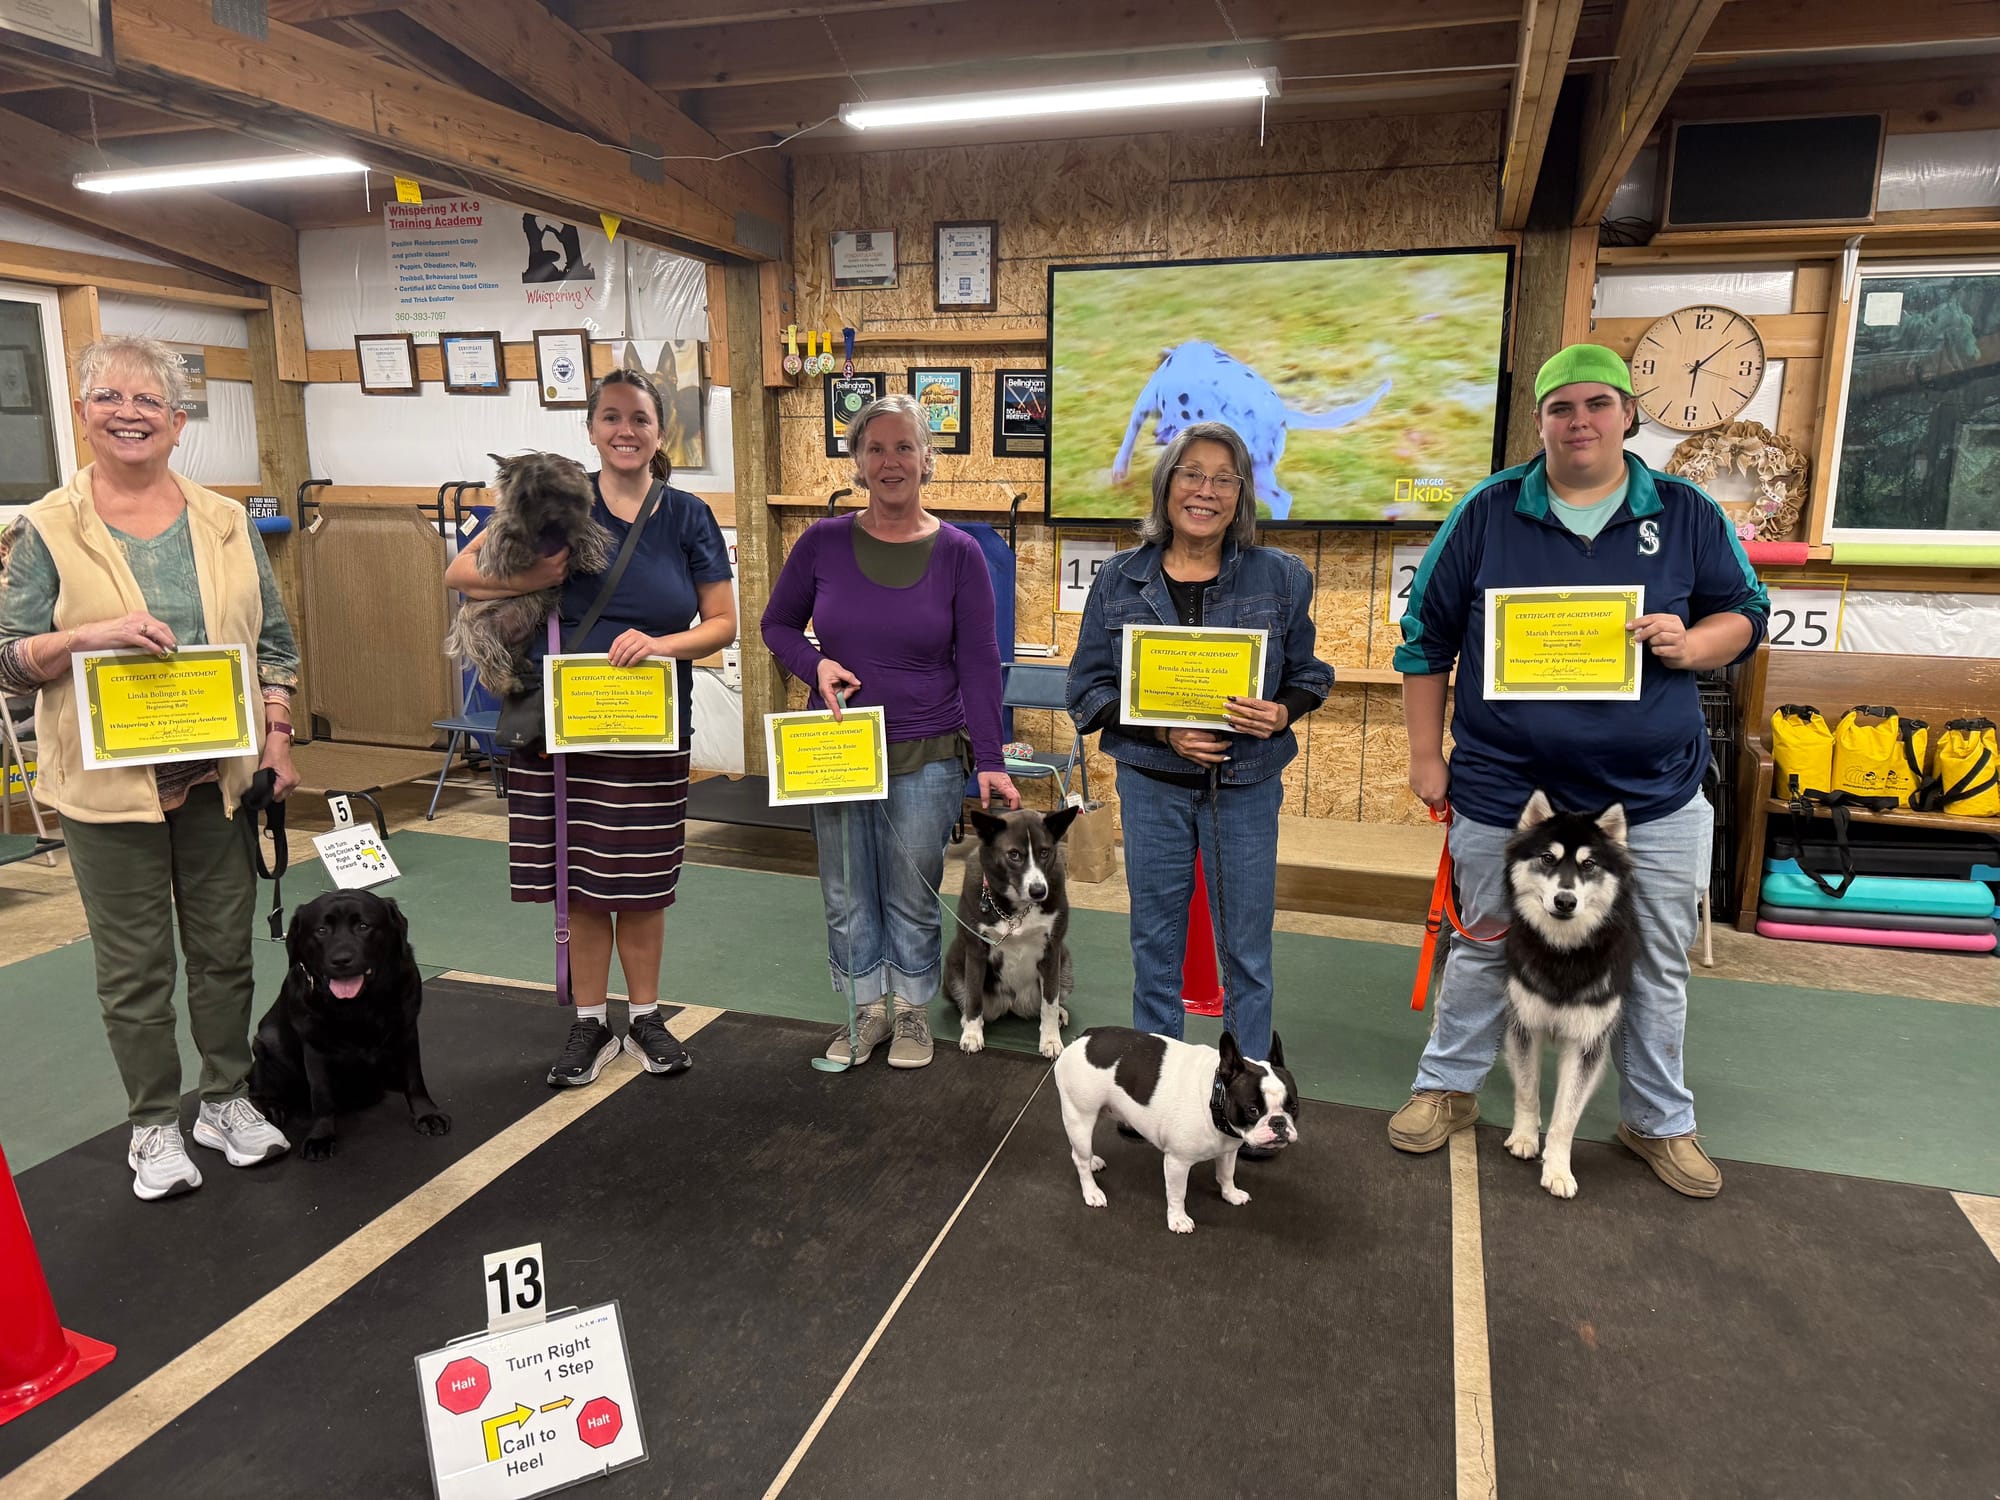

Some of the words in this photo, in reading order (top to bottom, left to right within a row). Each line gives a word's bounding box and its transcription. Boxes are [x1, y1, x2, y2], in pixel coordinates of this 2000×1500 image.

[389, 204, 447, 217] Whispering
[450, 202, 458, 213] X
[461, 201, 480, 212] K-9
[389, 218, 432, 229] Training
[435, 216, 482, 227] Academy
[414, 239, 459, 247] Reinforcement
[459, 261, 477, 269] Rally,
[425, 273, 458, 281] Behavioral
[429, 295, 455, 303] Evaluator
[526, 289, 584, 310] Whispering
[584, 286, 595, 301] X
[395, 311, 447, 321] 360-393-7097
[1695, 313, 1714, 330] 12
[1642, 359, 1655, 375] 9
[1739, 360, 1752, 376] 3
[920, 375, 955, 384] Bellingham
[1009, 378, 1046, 388] Bellingham
[836, 381, 871, 391] Bellingham
[1684, 405, 1697, 421] 6
[1414, 478, 1429, 486] NAT
[1429, 478, 1444, 486] GEO
[250, 507, 277, 518] HEART
[1397, 564, 1418, 599] 2
[1515, 612, 1555, 620] CERTIFICATE
[1525, 629, 1549, 637] Mariah
[1770, 609, 1828, 647] 25
[1150, 648, 1187, 656] CERTIFICATE
[1158, 664, 1179, 672] Brenda
[110, 673, 157, 682] CERTIFICATE
[169, 670, 218, 679] ACHIEVEMENT
[127, 691, 149, 700] Linda
[150, 689, 180, 699] Bolinger
[189, 688, 204, 696] Evie
[1144, 688, 1174, 696] Whispering
[175, 702, 189, 710] Rally
[109, 720, 149, 729] Whispering
[169, 718, 197, 726] Training
[198, 716, 228, 724] Academy
[830, 728, 863, 736] ACHIEVEMENT
[336, 800, 348, 822] 5
[324, 842, 336, 851] Left
[335, 840, 347, 848] Turn
[324, 852, 337, 860] Dog
[336, 846, 354, 856] Circles
[336, 855, 351, 863] Right
[336, 861, 358, 871] Forward
[488, 1256, 543, 1315] 13
[505, 1352, 544, 1372] Turn
[547, 1336, 592, 1361] Right
[544, 1369, 552, 1382] 1
[558, 1358, 595, 1379] Step
[451, 1376, 476, 1393] Halt
[587, 1413, 611, 1429] Halt
[503, 1431, 535, 1455] Call
[540, 1427, 557, 1443] to
[506, 1453, 544, 1477] Heel
